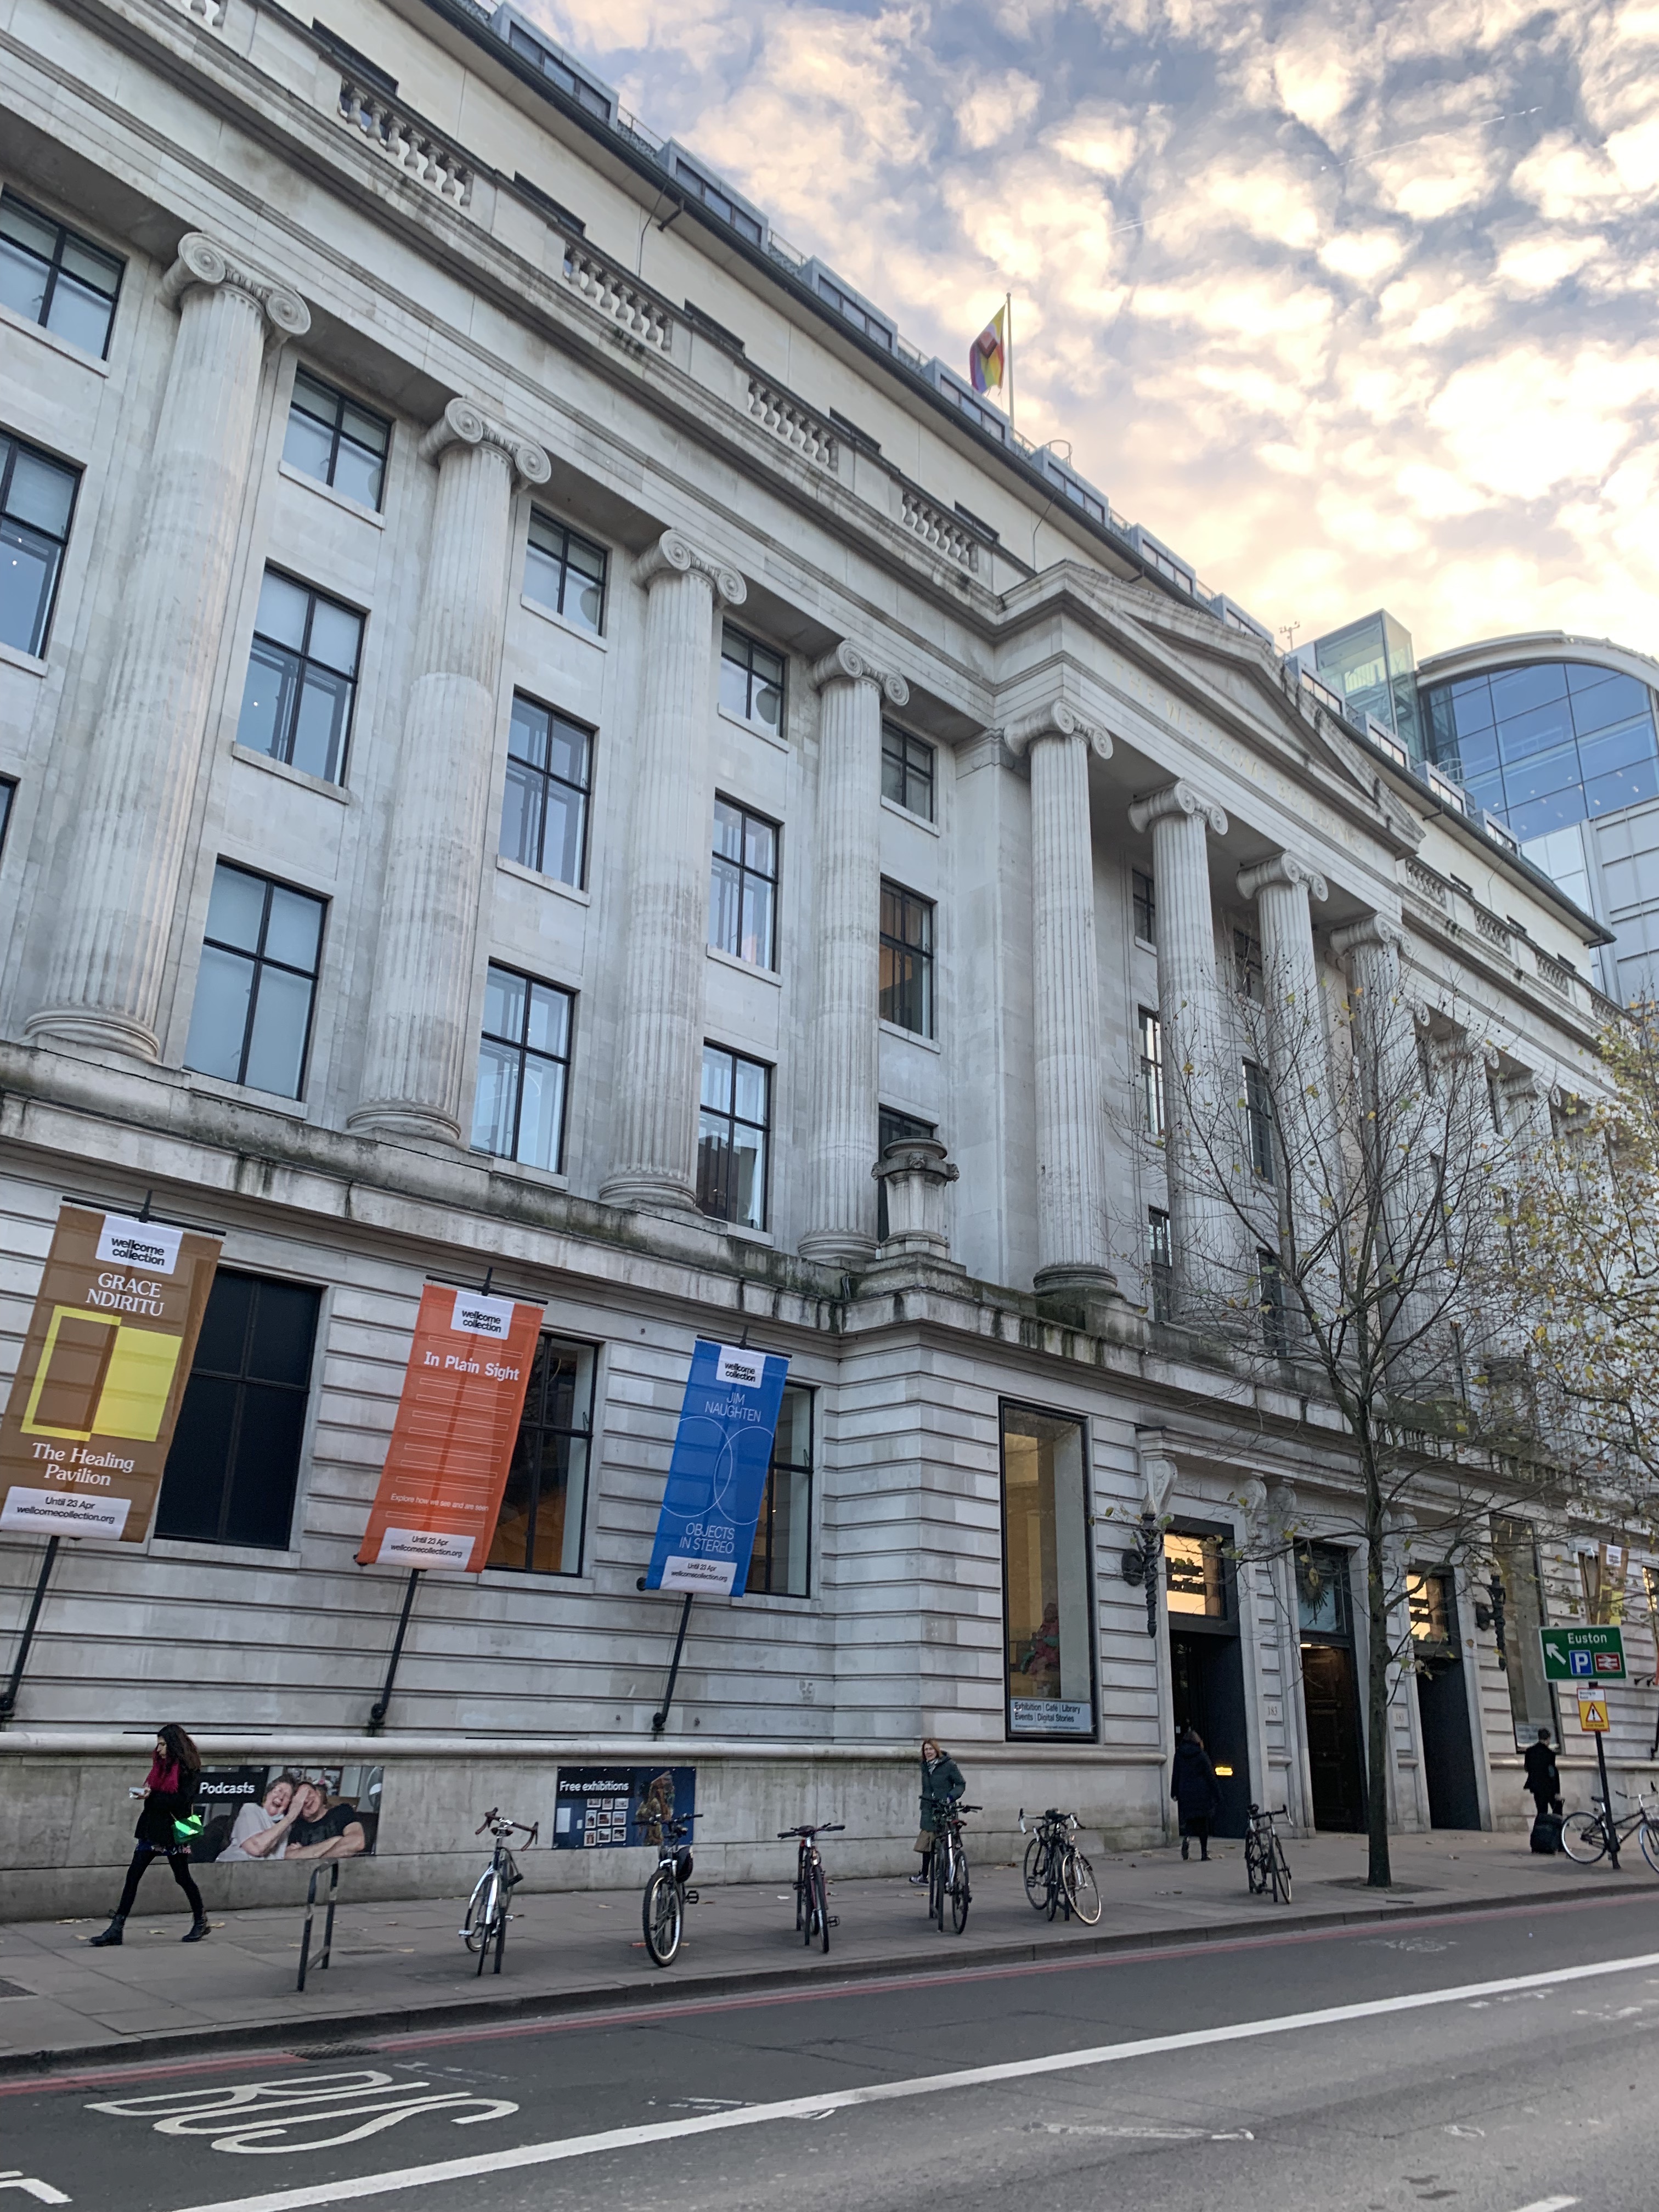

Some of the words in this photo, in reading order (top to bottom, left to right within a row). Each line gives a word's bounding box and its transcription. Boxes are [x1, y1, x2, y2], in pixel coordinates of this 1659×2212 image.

[111, 1238, 165, 1255] wellcome
[112, 1249, 165, 1266] collection
[98, 1272, 162, 1298] GRACE
[86, 1288, 165, 1316] NDIRITU
[462, 1310, 501, 1324] wellcome
[462, 1319, 501, 1333] collection
[424, 1351, 440, 1367] In
[444, 1355, 479, 1374] Plain
[484, 1362, 520, 1381] Sight
[725, 1363, 755, 1374] wellcome
[725, 1371, 756, 1382] collection
[726, 1392, 745, 1405] JIM
[704, 1401, 761, 1423] NAUGHTEN
[32, 1442, 65, 1461] The
[70, 1448, 136, 1474] Healing
[44, 1464, 111, 1486] Pavilion
[45, 1497, 65, 1505] Until
[78, 1501, 95, 1510] Apr
[390, 1493, 415, 1502] Explore
[17, 1506, 115, 1524] wellcomecollection.org
[685, 1522, 735, 1540] OBJECTS
[391, 1544, 462, 1558] wellcomecollection.org
[679, 1536, 692, 1549] IN
[692, 1537, 735, 1554] STEREO
[1567, 1632, 1607, 1644] Euston
[1575, 1652, 1589, 1673] P
[1014, 1702, 1042, 1711] Exhibition
[1045, 1703, 1058, 1712] Café
[1062, 1704, 1081, 1714] Library
[1268, 1706, 1278, 1716] 183
[1015, 1712, 1034, 1720] Events
[1037, 1713, 1055, 1723] Digital
[1055, 1713, 1075, 1723] Stories
[199, 1781, 255, 1794] Podcasts
[559, 1781, 582, 1791] Free
[582, 1780, 629, 1791] exhibitions
[84, 2070, 519, 2154] BUS
